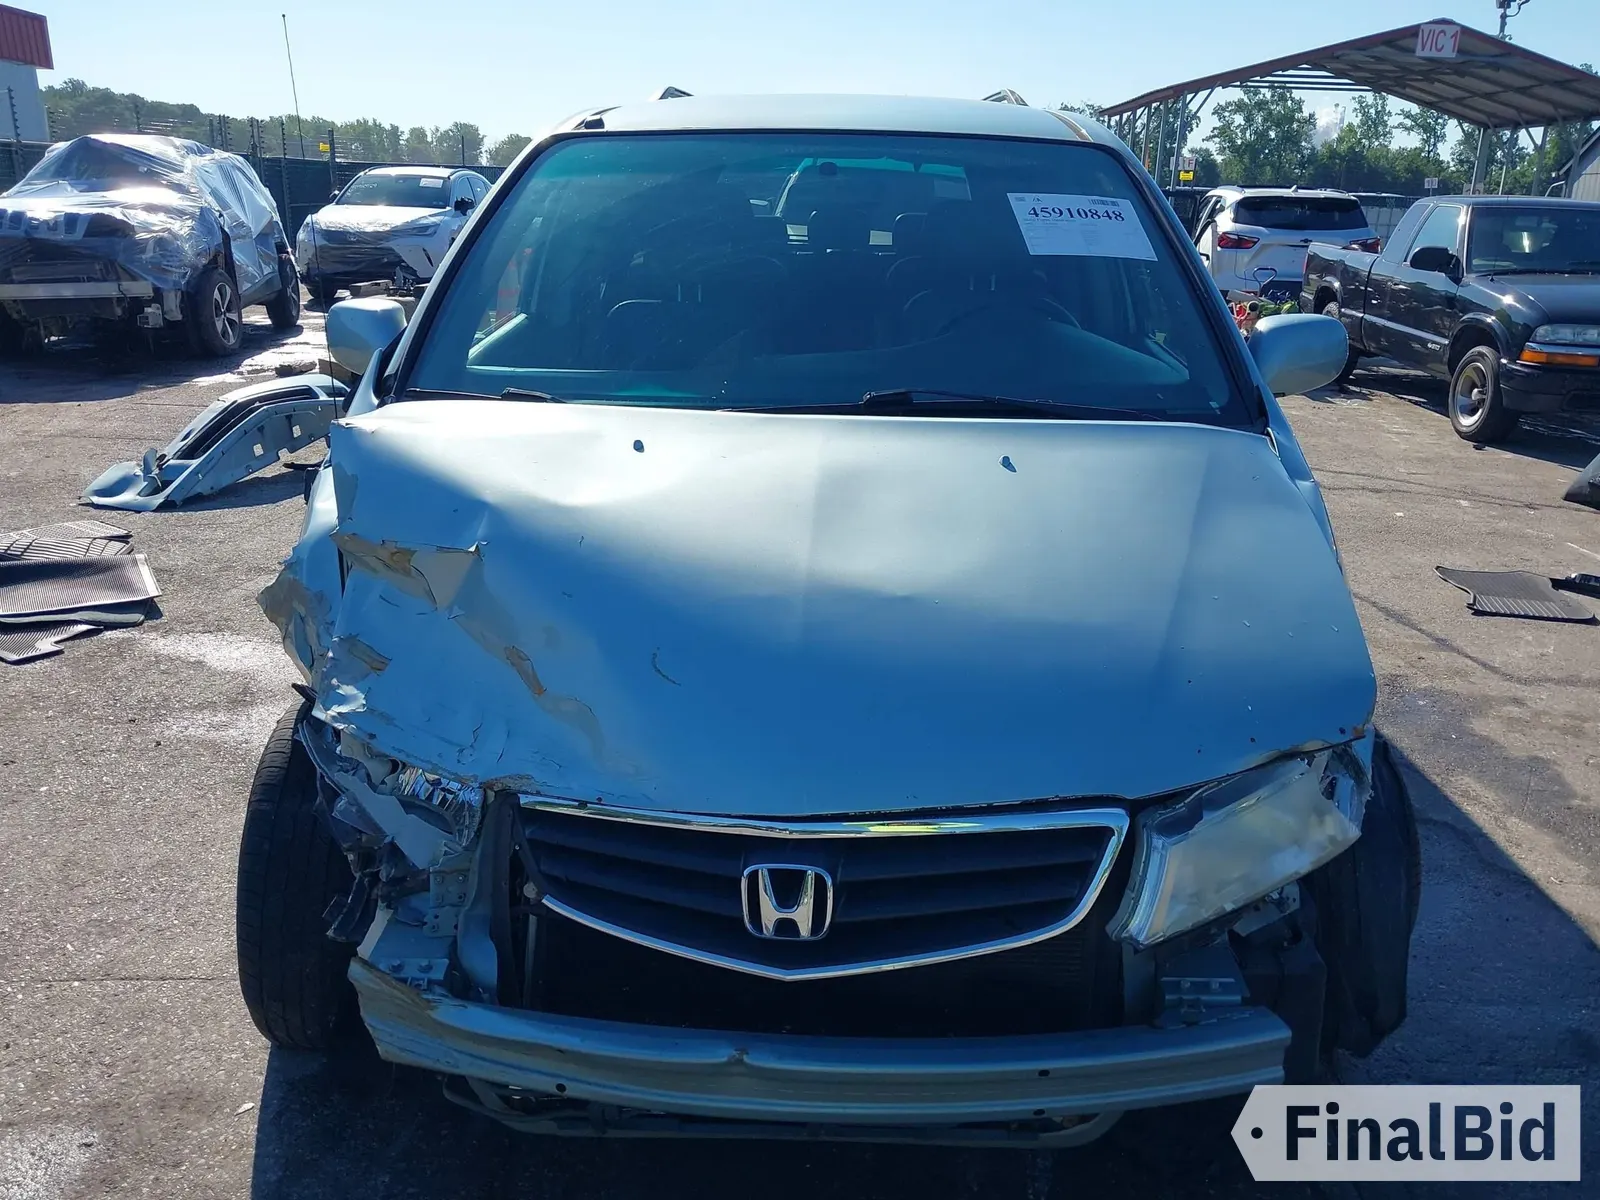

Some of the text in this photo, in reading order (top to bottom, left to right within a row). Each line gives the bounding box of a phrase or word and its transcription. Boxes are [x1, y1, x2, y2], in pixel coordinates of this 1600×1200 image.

[1421, 29, 1459, 53] VIC 1
[1028, 206, 1125, 222] 45910848
